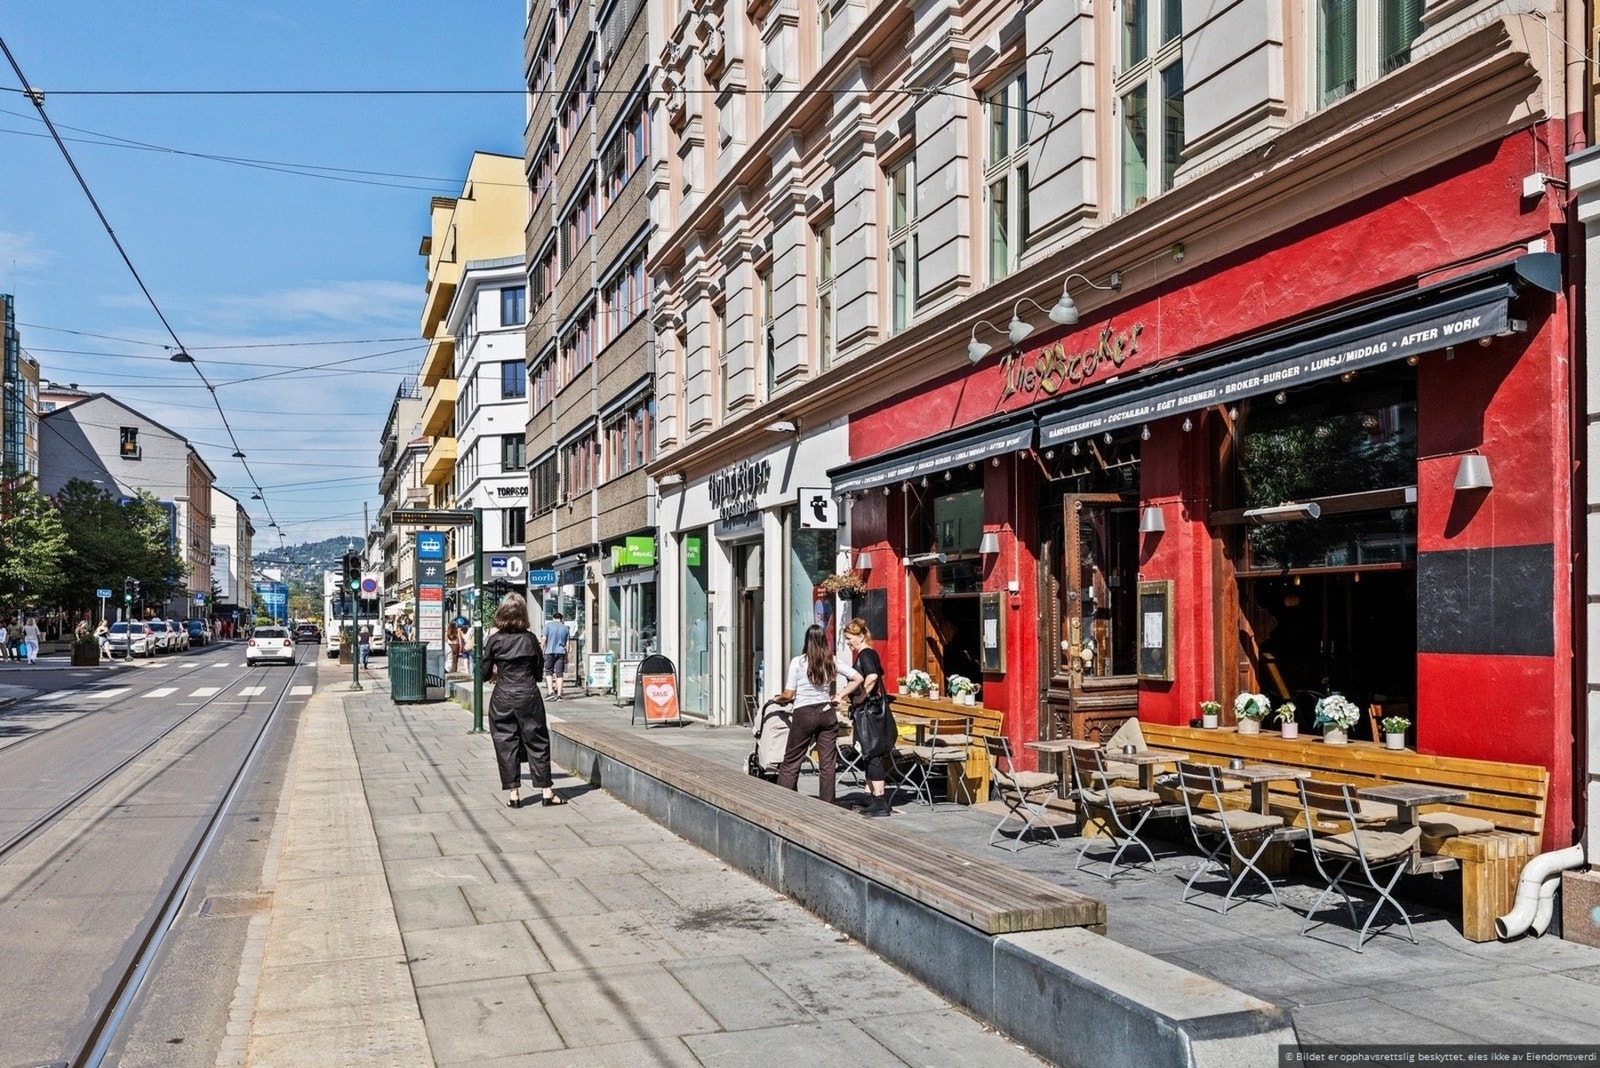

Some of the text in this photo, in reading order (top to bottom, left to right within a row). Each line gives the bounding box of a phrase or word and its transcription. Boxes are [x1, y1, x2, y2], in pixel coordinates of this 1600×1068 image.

[1049, 316, 1482, 438] HÅNDVERKSBRYGG COCTAILBAR EGET BRENNERI BROKER-BURGER LUNSJ/MIDDAG AFTER WORK
[989, 439, 1005, 451] AFTER
[531, 572, 554, 582] norli
